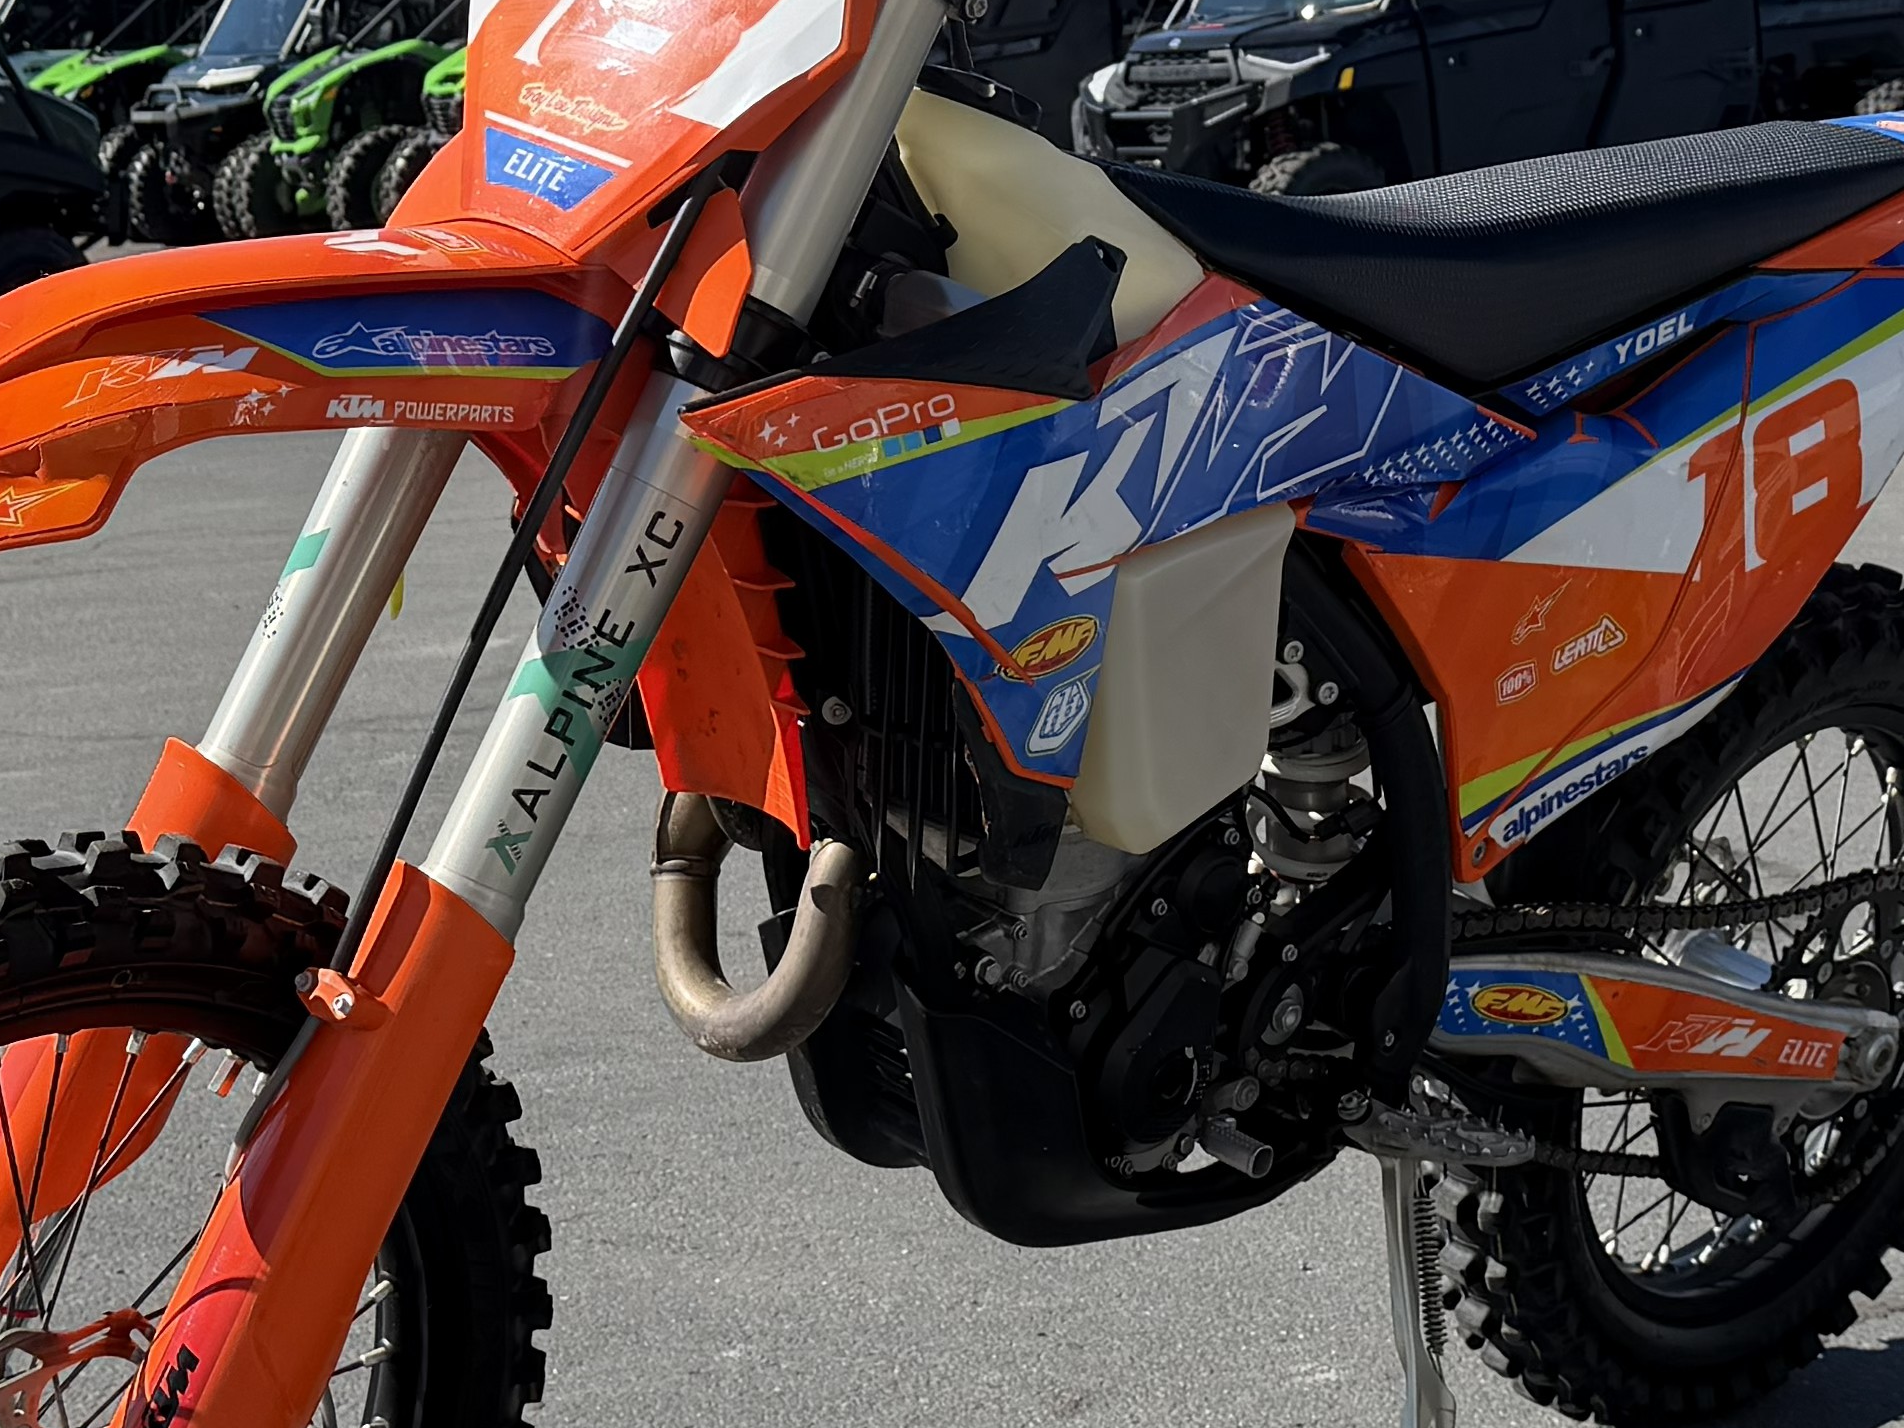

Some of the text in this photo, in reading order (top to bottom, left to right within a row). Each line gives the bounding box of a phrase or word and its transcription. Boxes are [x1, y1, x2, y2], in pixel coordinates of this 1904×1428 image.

[377, 329, 557, 360] alpinestars
[1614, 313, 1694, 365] YOEL
[325, 394, 515, 424] KTM POWERPARTS
[811, 393, 956, 454] GoPro
[1686, 378, 1864, 572] 18
[626, 510, 686, 589] XC
[1015, 618, 1095, 669] FMF
[1501, 668, 1534, 697] 100%
[1502, 745, 1650, 844] alpinestars
[1473, 989, 1569, 1019] FMF
[1633, 1013, 1773, 1058] KTM
